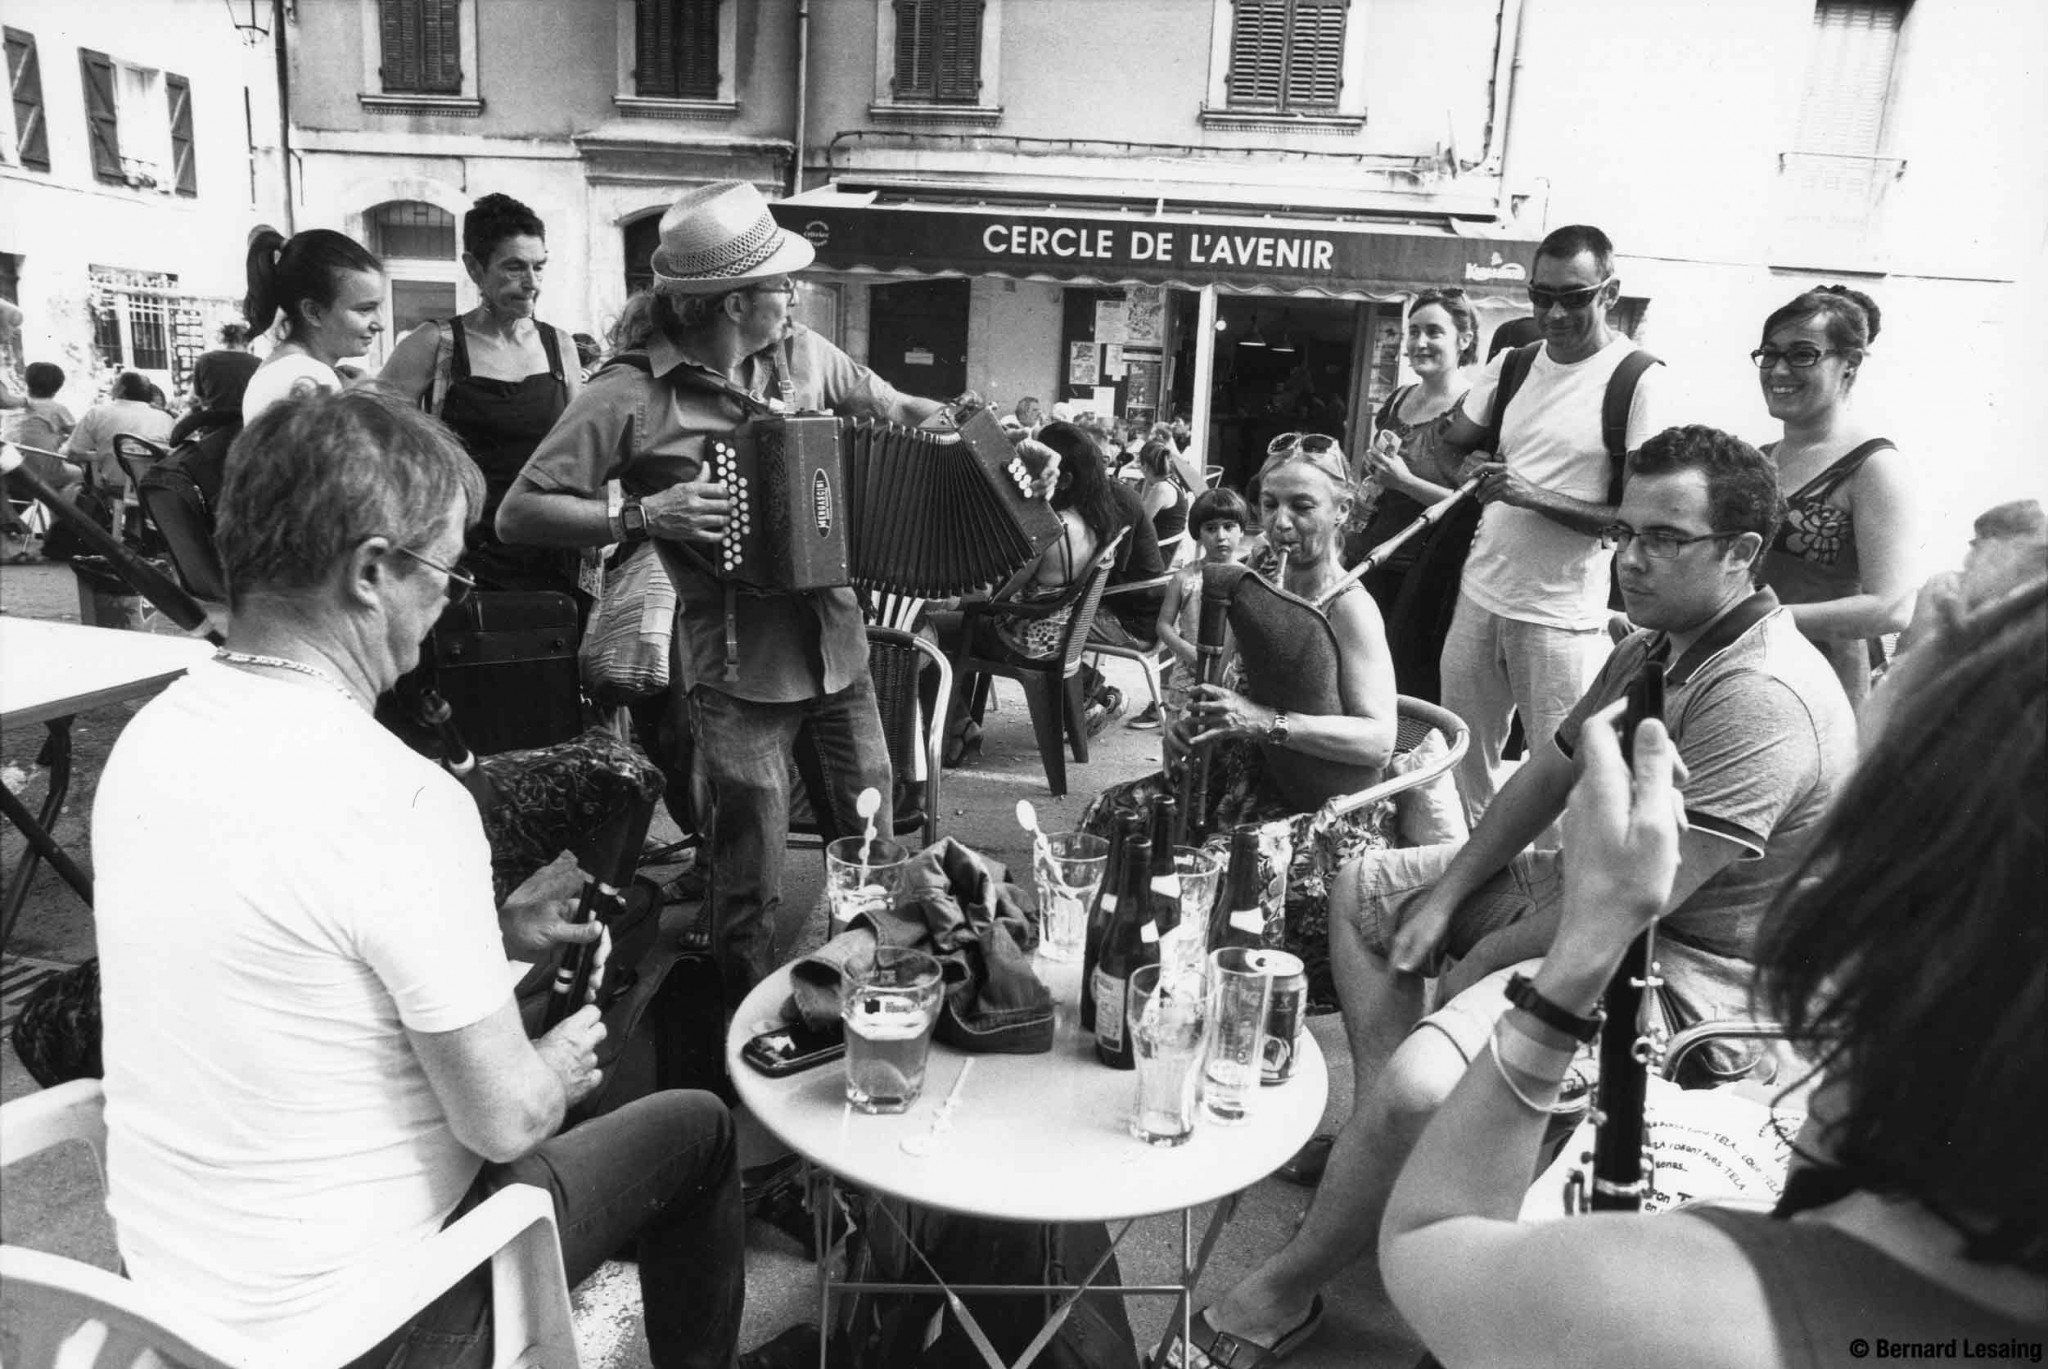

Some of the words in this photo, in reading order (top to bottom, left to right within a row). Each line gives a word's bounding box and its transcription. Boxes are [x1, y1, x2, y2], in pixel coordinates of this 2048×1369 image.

[983, 224, 1113, 258] CERCLE
[1131, 231, 1173, 261] DE
[1190, 234, 1335, 269] L'AVENIR
